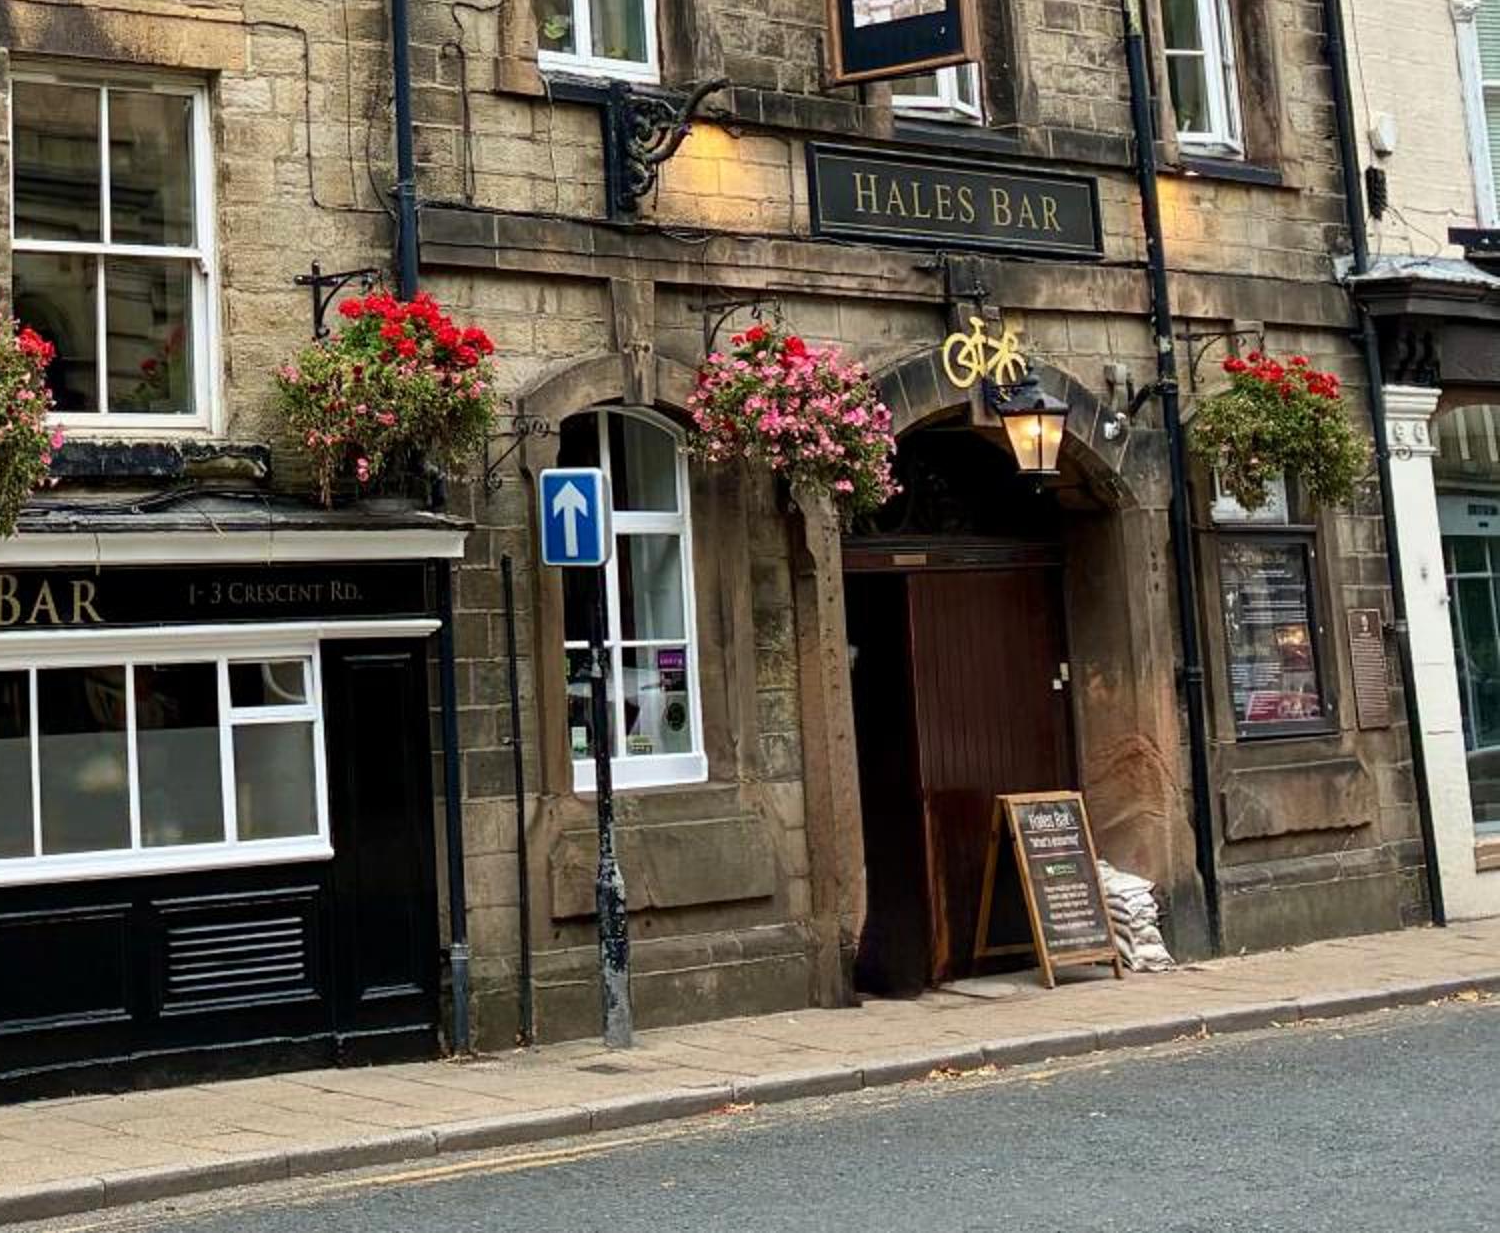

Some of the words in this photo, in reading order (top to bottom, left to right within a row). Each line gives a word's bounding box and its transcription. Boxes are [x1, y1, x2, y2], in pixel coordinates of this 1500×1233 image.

[851, 171, 976, 224] HALES
[990, 187, 1062, 232] BAR
[228, 581, 324, 605] CRESCENT
